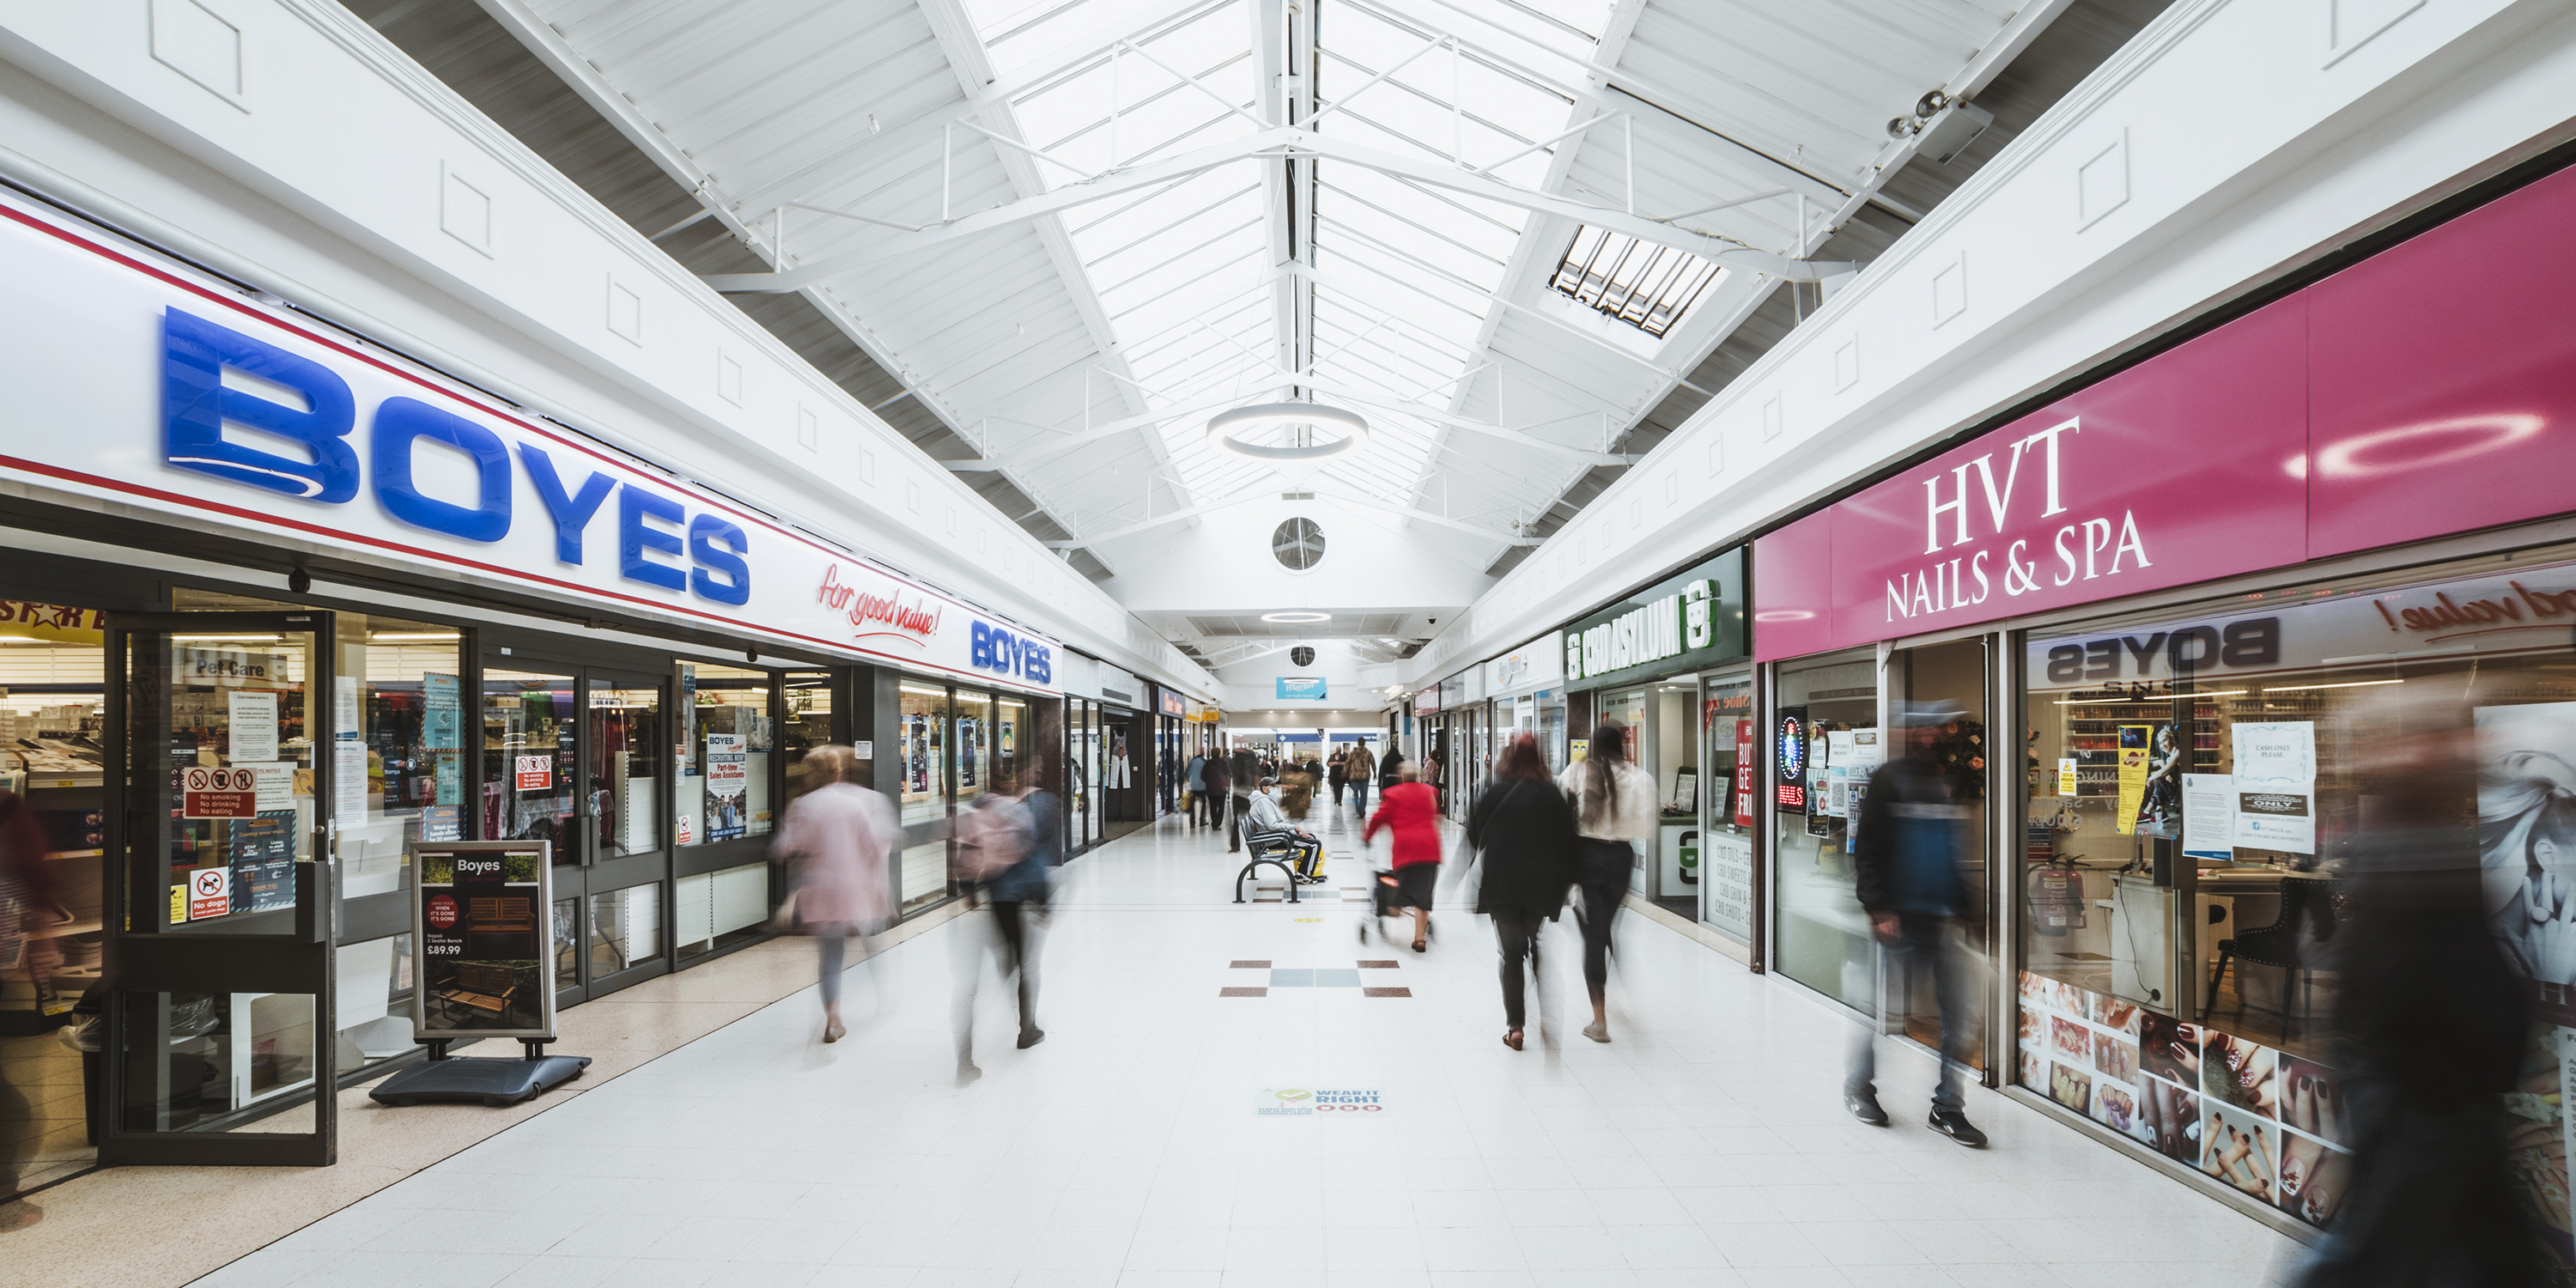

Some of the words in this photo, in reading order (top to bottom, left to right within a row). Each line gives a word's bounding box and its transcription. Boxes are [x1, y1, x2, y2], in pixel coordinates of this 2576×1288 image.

[163, 305, 750, 606] BOYES
[1923, 415, 2080, 555] HVT
[1886, 550, 1989, 622] NAILS
[2004, 539, 2041, 597] &
[2054, 509, 2153, 586] SPA
[818, 563, 854, 611] for
[849, 588, 900, 626] good
[971, 619, 1051, 684] BOYES
[197, 659, 224, 674] Pet
[229, 661, 264, 677] Care
[2255, 744, 2271, 753] CASH
[2273, 744, 2291, 753] ONLY
[2261, 750, 2286, 759] PLEASE.
[1849, 767, 1860, 776] HVT
[1717, 845, 1726, 860] CBD
[1728, 847, 1738, 863] OILS
[458, 860, 500, 875] Boyes
[1717, 863, 1726, 878] CBD
[1728, 866, 1747, 884] SWEETS
[1720, 883, 1729, 897] CBD
[1730, 886, 1741, 902] SKIN
[1716, 899, 1724, 914] CBD
[1726, 903, 1741, 921] SHOTS
[428, 945, 460, 955] £89.99
